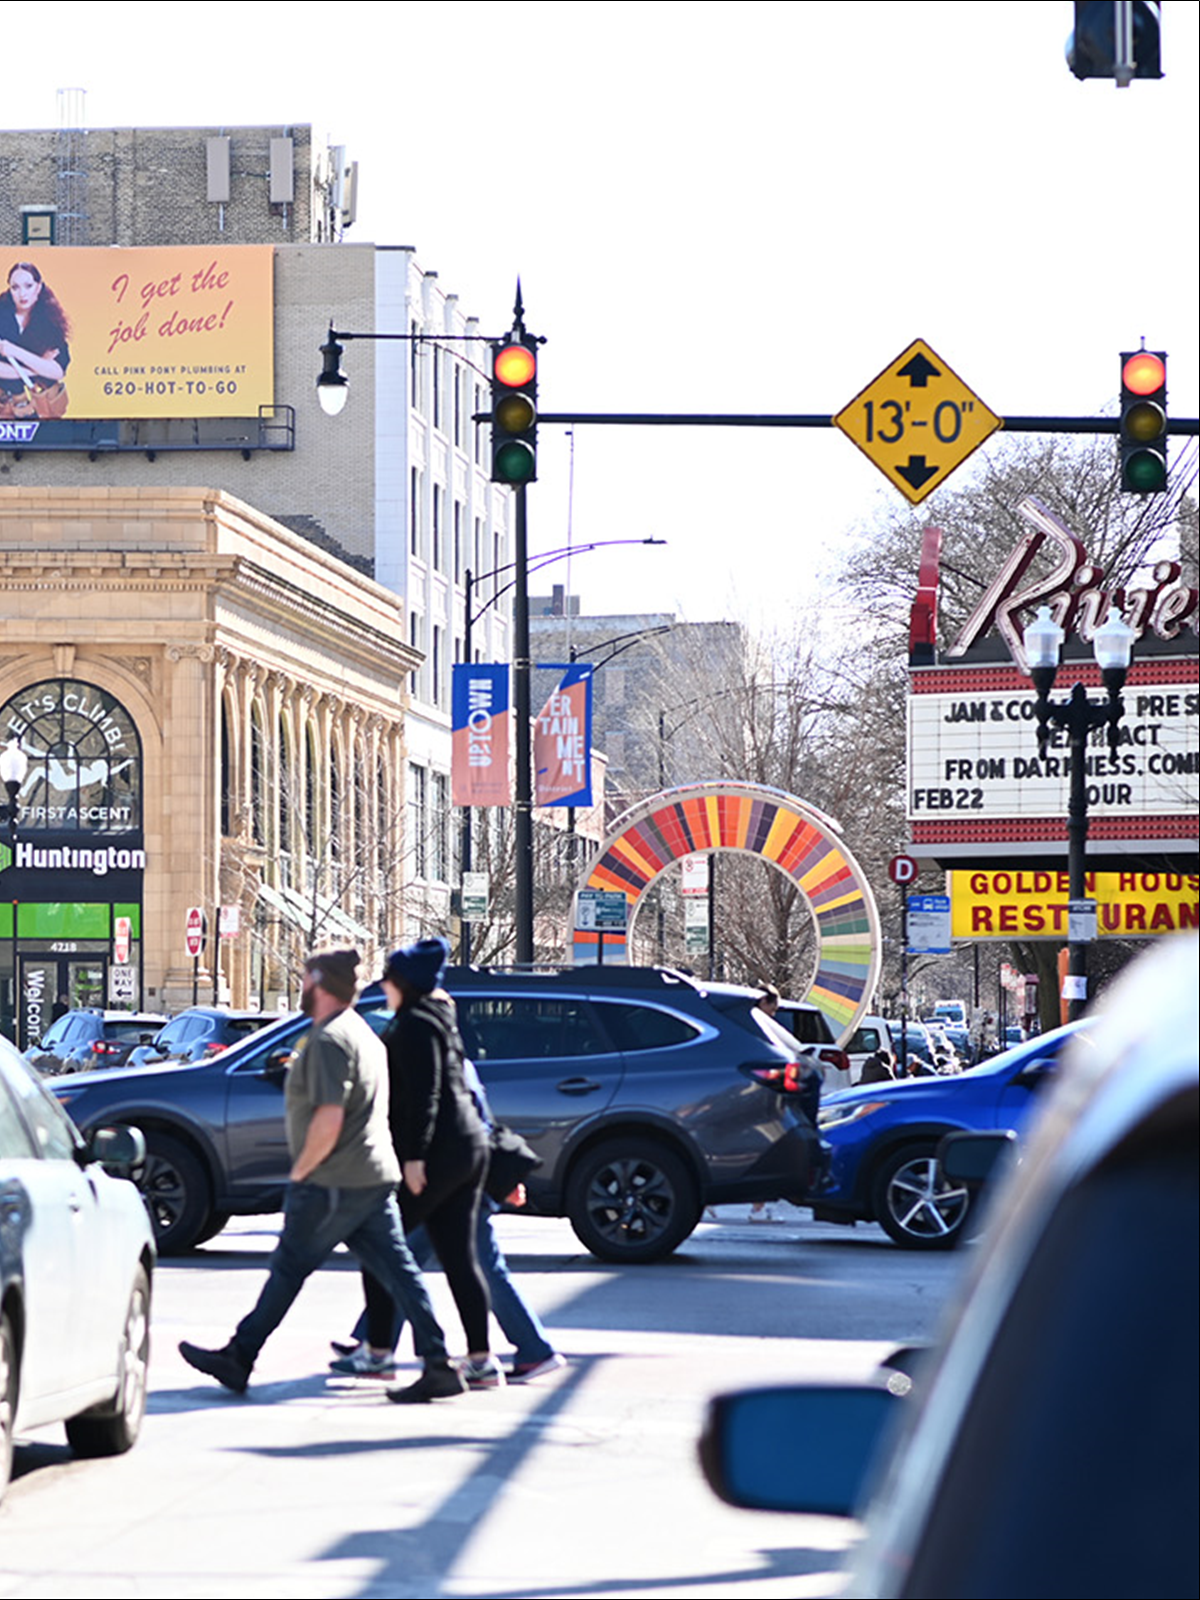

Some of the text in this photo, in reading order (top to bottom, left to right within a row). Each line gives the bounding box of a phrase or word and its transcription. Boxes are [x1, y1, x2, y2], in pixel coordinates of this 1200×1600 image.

[111, 261, 229, 309] I get the
[108, 300, 234, 354] job done!
[94, 365, 246, 375] CALL PINK PONY PLUMBING AT
[103, 380, 237, 395] 620-HOT-TO-GO
[7, 694, 126, 751] ET'S CLIMB!
[468, 679, 492, 767] UPTOWN
[557, 735, 584, 759] ME
[945, 758, 1005, 781] FROM
[1084, 783, 1132, 806] OUR
[16, 843, 145, 875] Huntington
[895, 861, 913, 880] D
[970, 871, 1096, 894] GOLDEN
[972, 902, 1199, 932] RESTURAN
[114, 969, 132, 977] ONE
